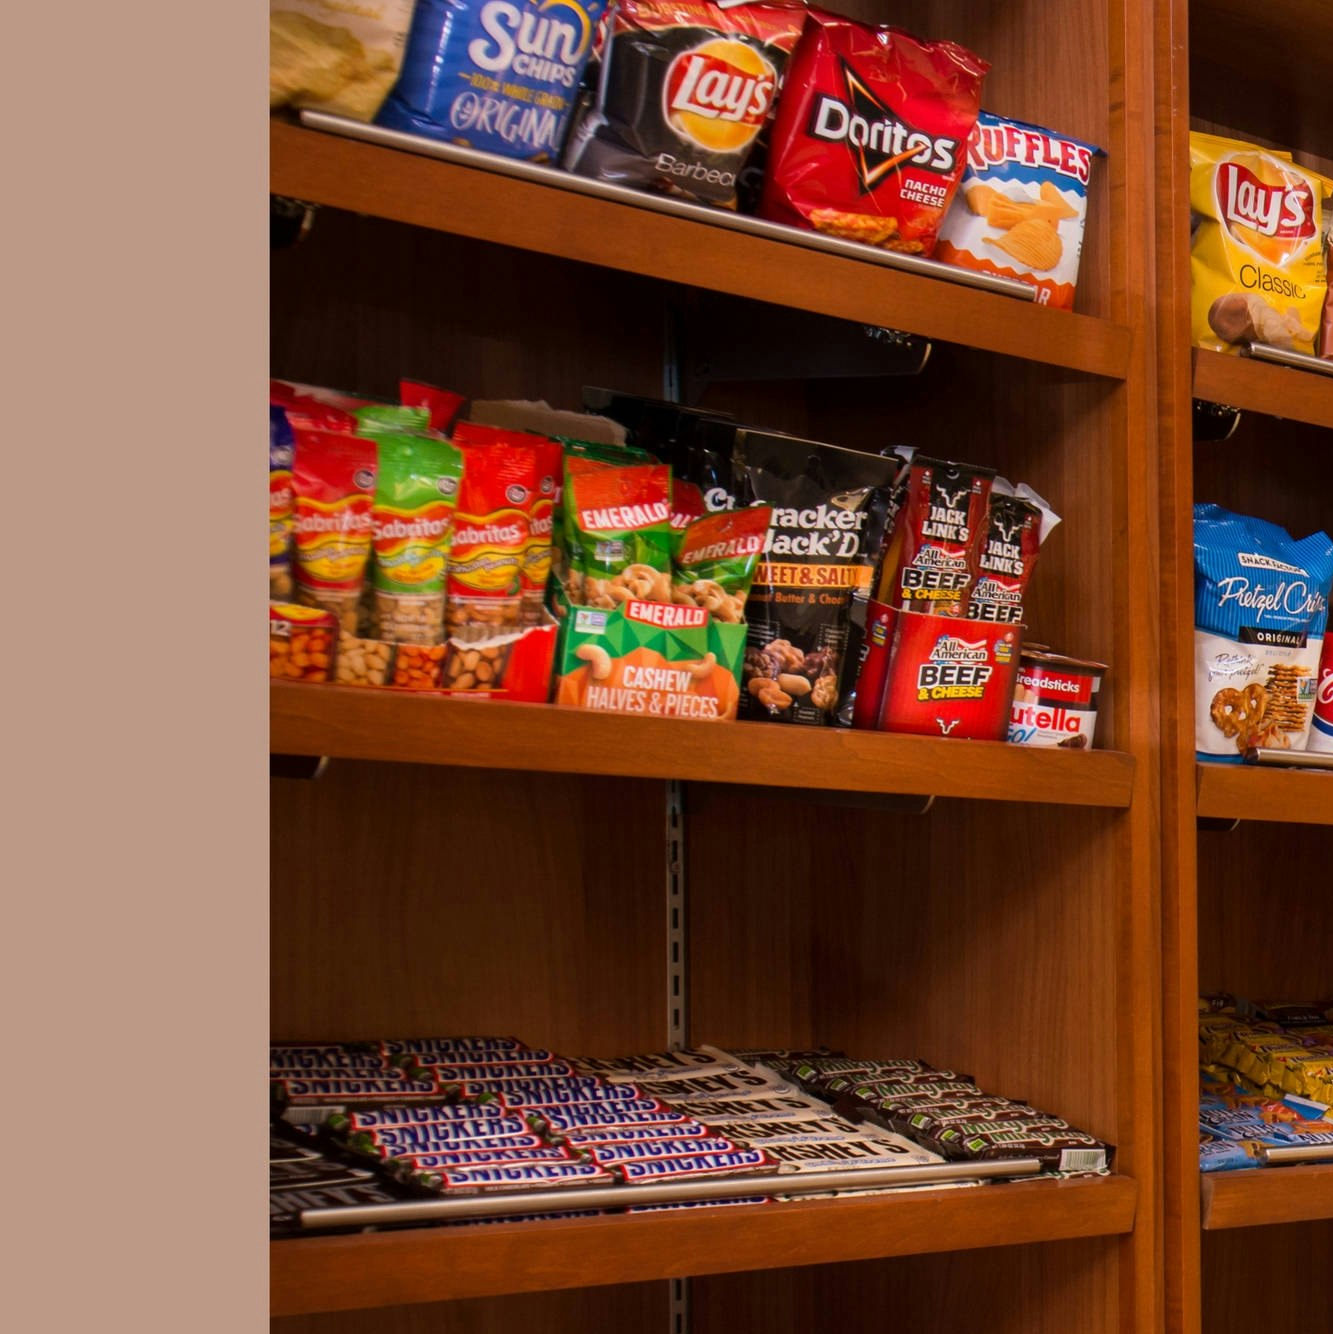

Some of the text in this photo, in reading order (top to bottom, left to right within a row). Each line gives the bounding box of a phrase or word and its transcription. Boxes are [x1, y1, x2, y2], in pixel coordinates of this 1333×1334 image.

[468, 2, 580, 71] Sun
[512, 53, 577, 88] CHIPS
[672, 55, 774, 122] Lay's
[812, 97, 957, 171] Doritos
[967, 122, 1091, 185] RUFFLES
[900, 189, 946, 209] CHEESE
[904, 178, 947, 199] NACHO
[1226, 162, 1309, 236] Lay's
[1238, 263, 1307, 301] Classic
[582, 502, 668, 529] EMERALD
[930, 505, 966, 526] JACK
[373, 516, 450, 541] Sabritas
[921, 523, 969, 542] LINK'S
[682, 536, 760, 564] EMERALD
[988, 540, 1021, 559] JACK
[914, 554, 966, 569] American
[980, 555, 1024, 575] LINK'S
[1241, 555, 1270, 568] SNACK
[815, 567, 859, 587] SALTY
[902, 568, 971, 590] BEEF
[913, 588, 961, 601] CHEESE
[972, 587, 1021, 603] American
[1218, 577, 1285, 623] Pretzel
[629, 602, 707, 628] EMERALD
[967, 602, 1023, 625] BEEF
[1257, 632, 1300, 645] ORIGINAL
[932, 646, 987, 662] American
[623, 664, 690, 691] CASHEW
[919, 664, 992, 687] BEEF
[586, 687, 718, 718] HALVES & PIECES
[931, 686, 984, 699] CHEESE
[1009, 706, 1081, 733] utella
